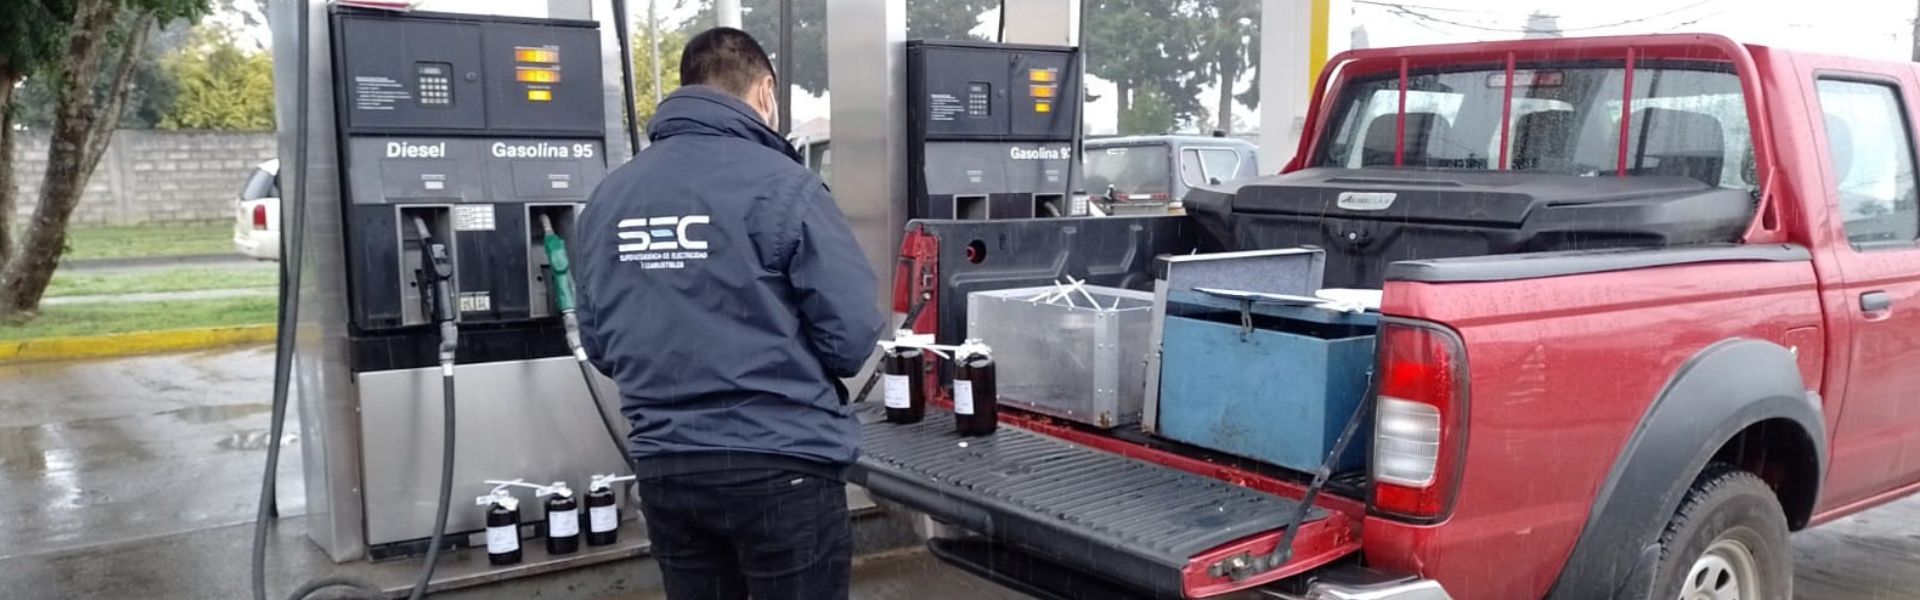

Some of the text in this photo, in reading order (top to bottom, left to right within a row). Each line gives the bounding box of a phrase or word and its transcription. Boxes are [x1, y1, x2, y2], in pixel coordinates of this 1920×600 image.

[386, 142, 446, 158] Diesel
[491, 142, 593, 158] Gasolina 95
[1010, 147, 1059, 159] Gasolina
[618, 215, 710, 252] SEC
